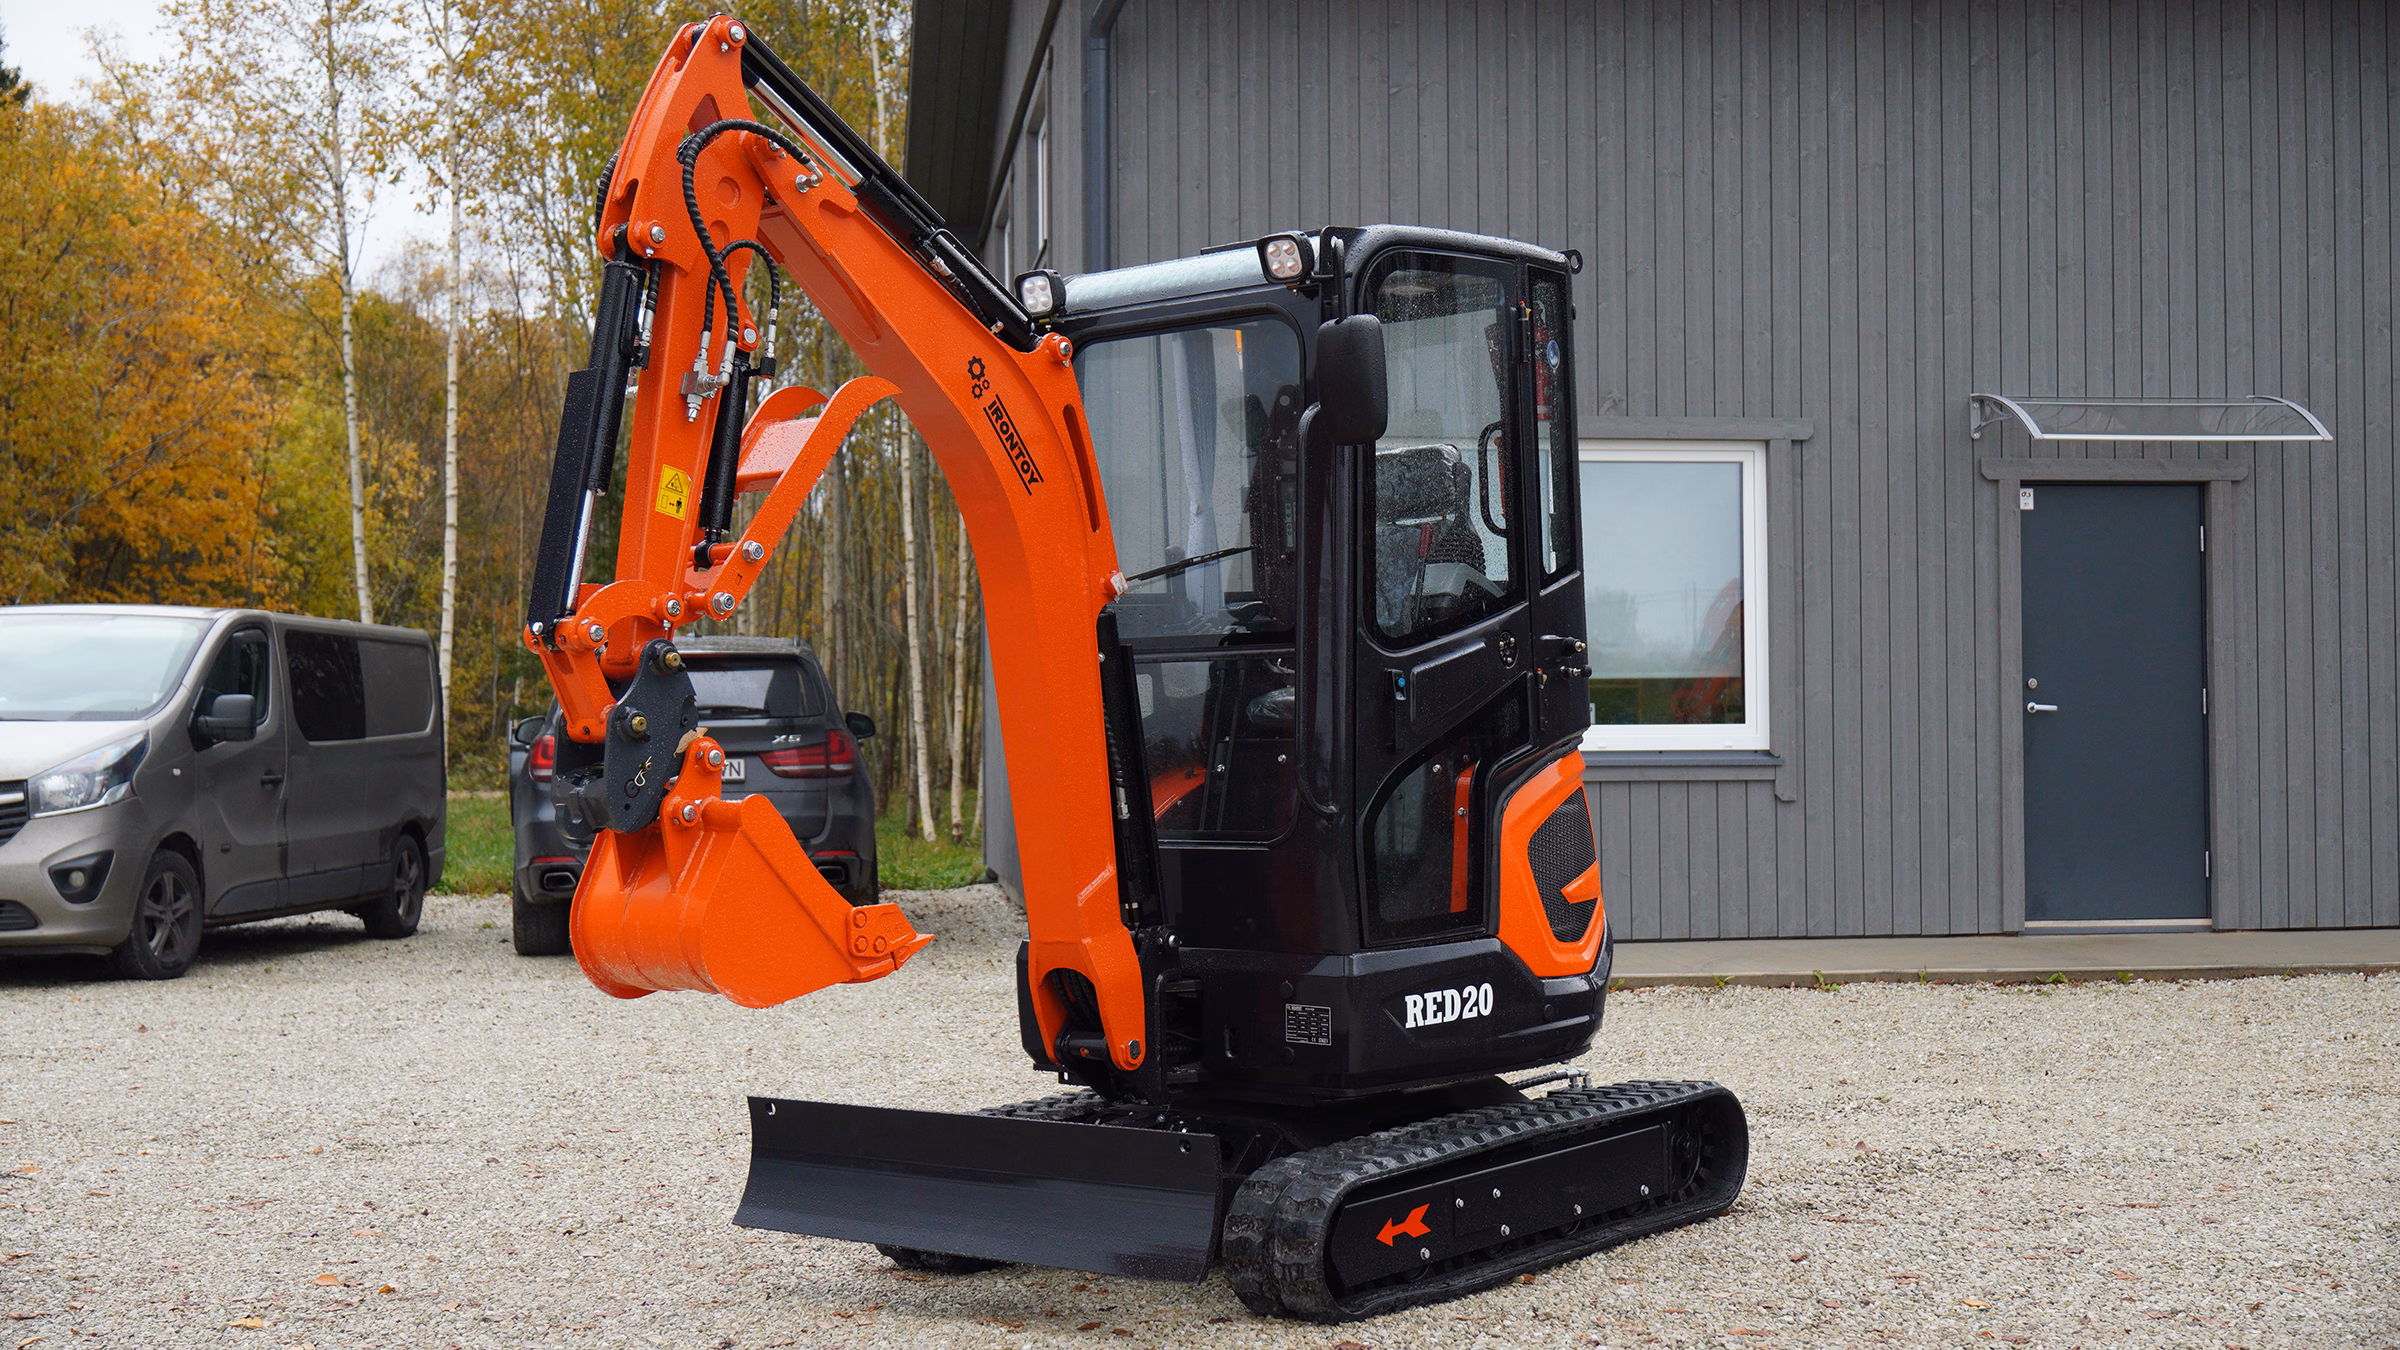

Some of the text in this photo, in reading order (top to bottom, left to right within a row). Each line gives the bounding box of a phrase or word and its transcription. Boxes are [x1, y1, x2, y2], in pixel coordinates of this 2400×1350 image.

[988, 399, 1040, 486] IRONTOY
[771, 734, 802, 743] X5
[1405, 982, 1494, 1029] RED20
